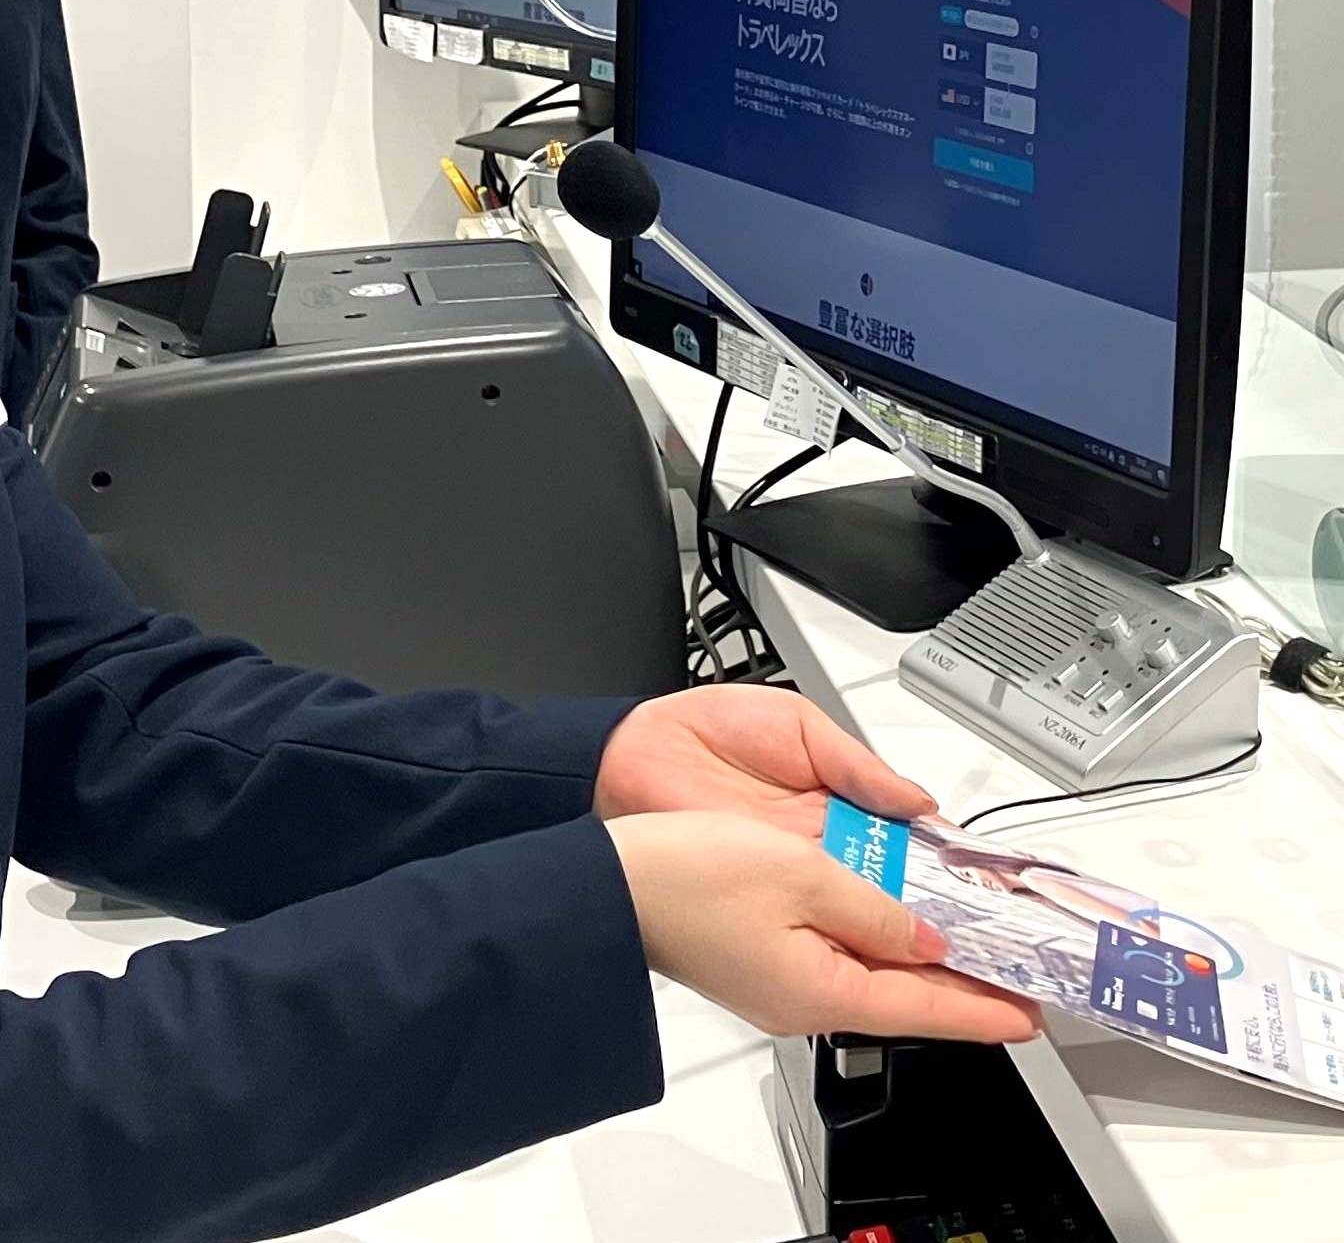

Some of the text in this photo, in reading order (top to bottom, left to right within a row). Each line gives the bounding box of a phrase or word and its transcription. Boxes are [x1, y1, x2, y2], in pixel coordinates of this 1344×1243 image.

[737, 13, 826, 67] トラベレックス
[817, 299, 916, 363] 豊富な選択肢
